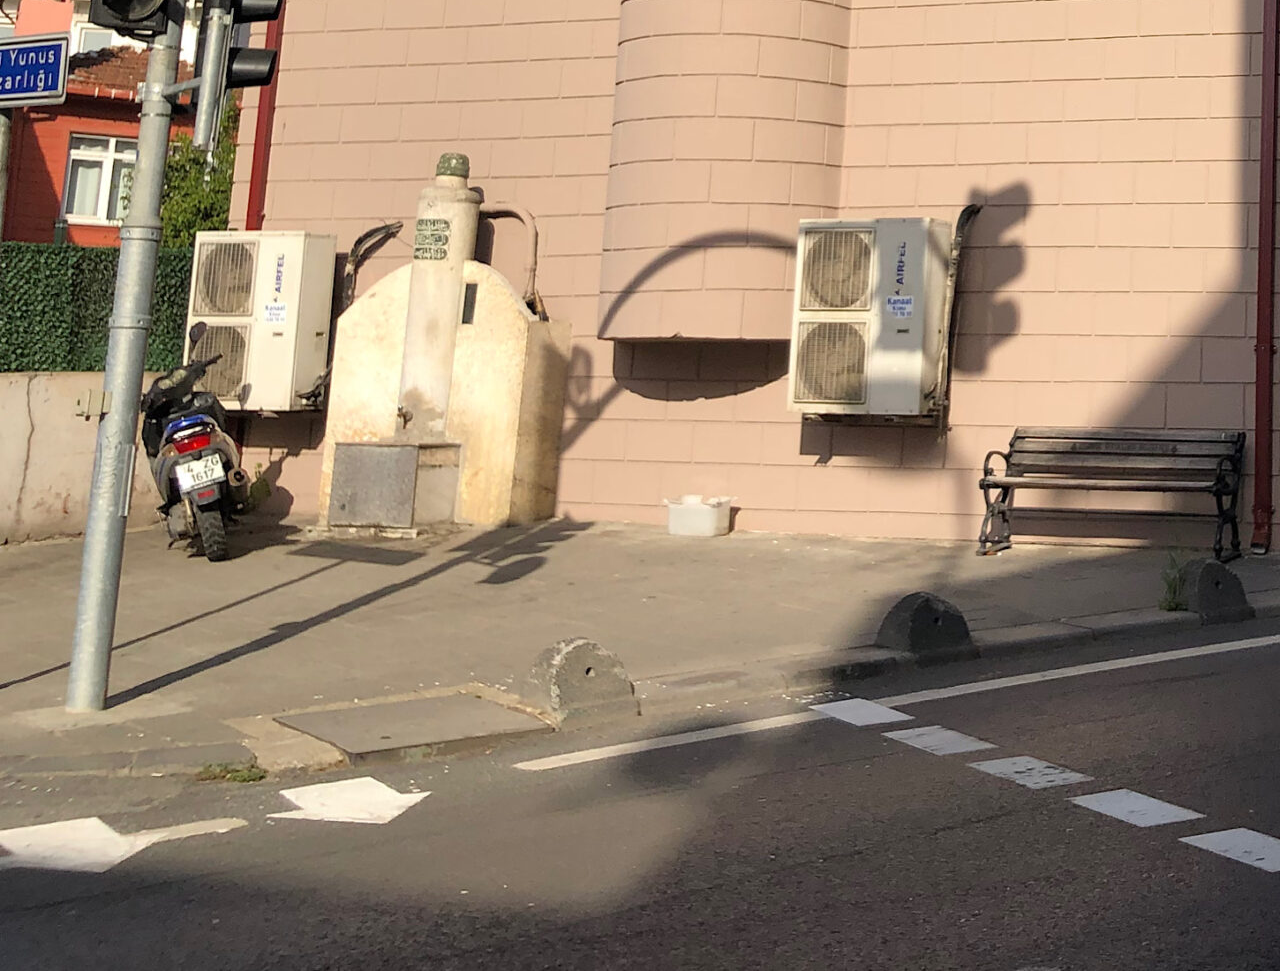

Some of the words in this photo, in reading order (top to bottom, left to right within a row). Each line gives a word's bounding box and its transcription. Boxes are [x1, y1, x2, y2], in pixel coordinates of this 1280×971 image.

[10, 49, 55, 67] Yunus
[275, 253, 285, 293] AIRFEL
[896, 241, 906, 285] AIRFEL
[191, 467, 215, 483] 1617
